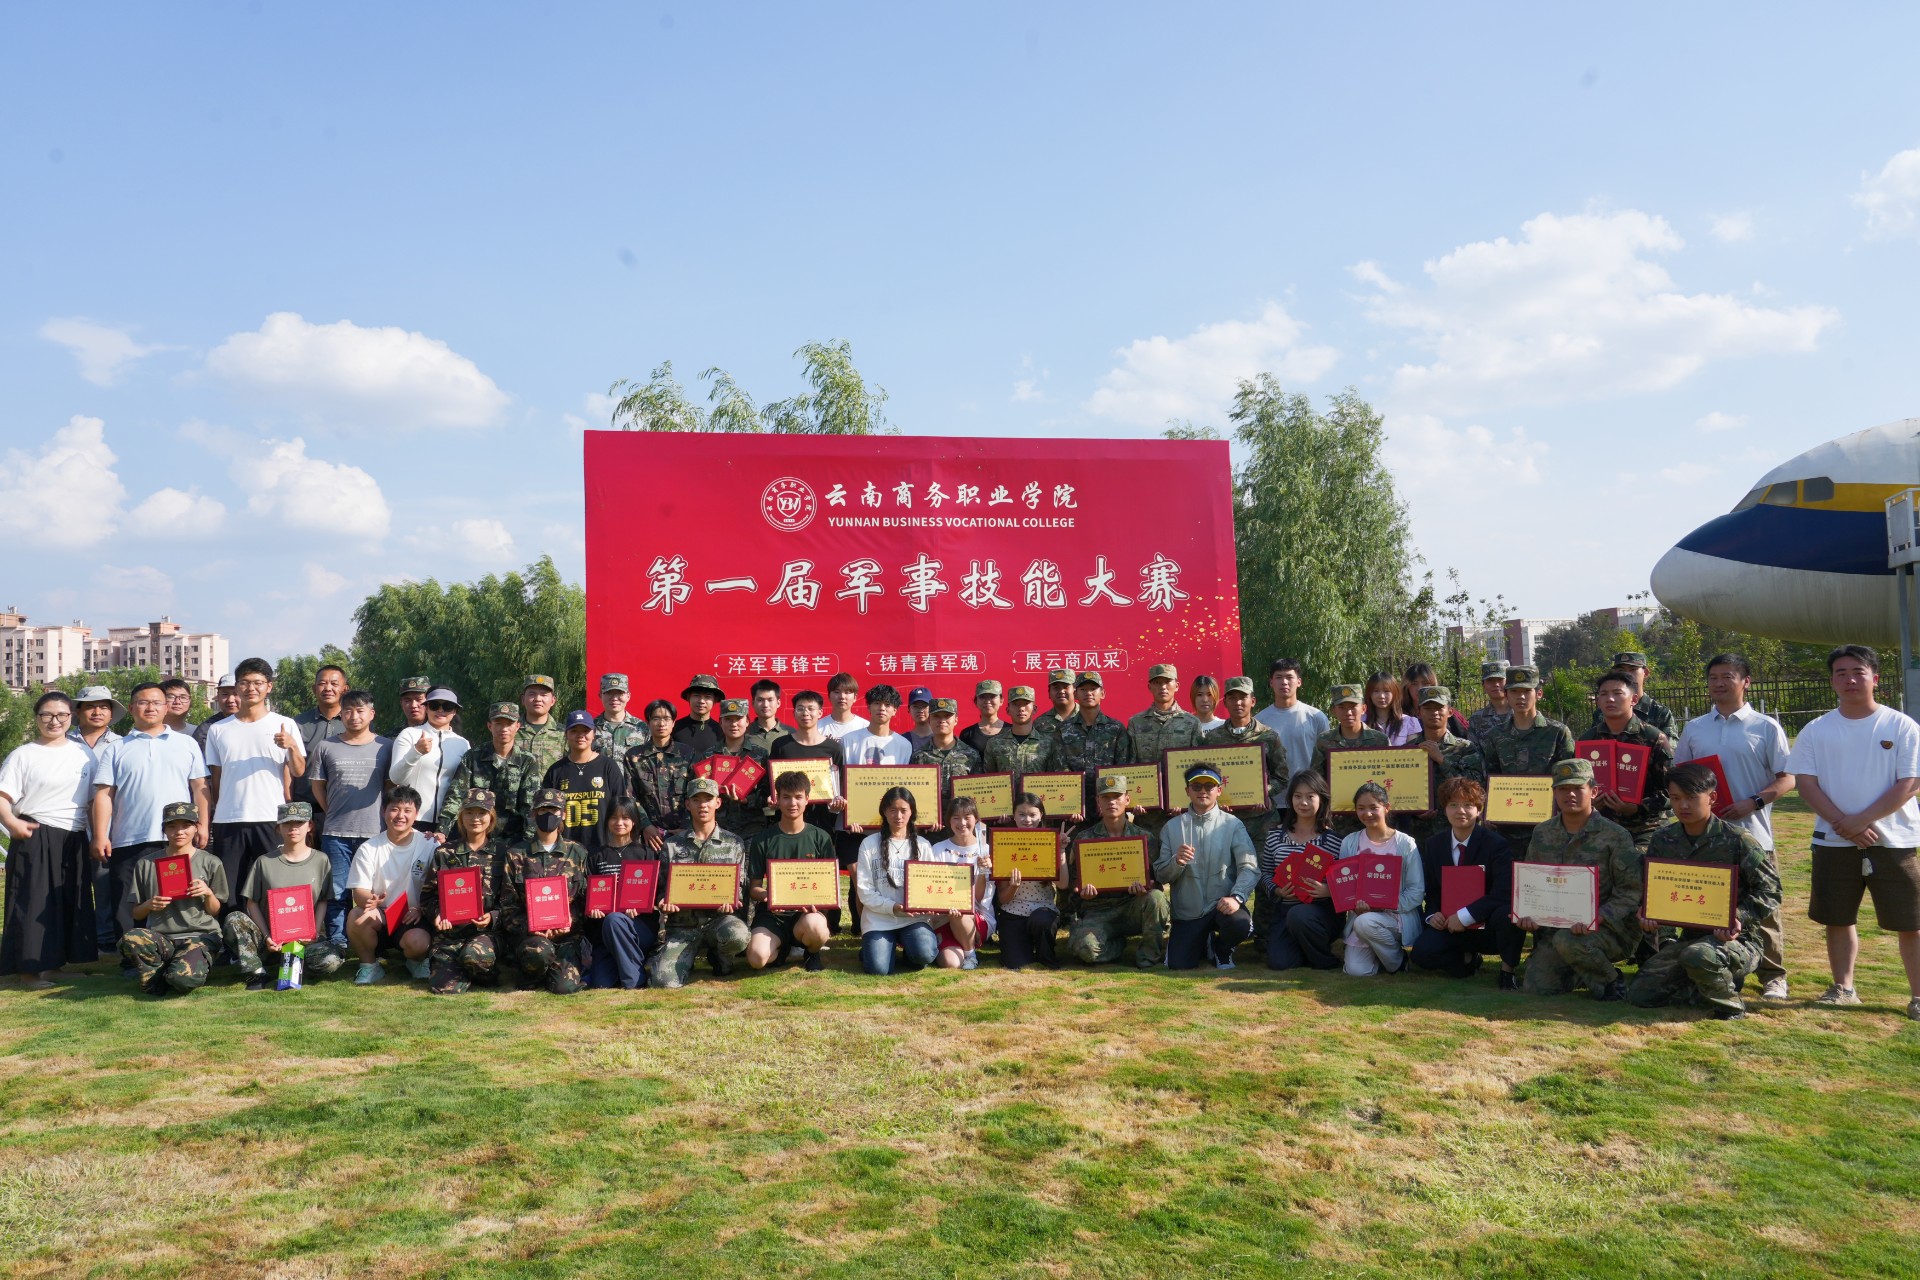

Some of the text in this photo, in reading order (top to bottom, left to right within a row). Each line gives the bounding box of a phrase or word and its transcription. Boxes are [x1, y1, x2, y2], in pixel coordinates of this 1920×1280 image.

[825, 480, 1078, 510] 云南商务职业学院
[828, 517, 1075, 528] YUNNAN BUSINESS VOCATIONAL COLLEGE
[641, 552, 1189, 615] 第一届军事技能大赛
[728, 656, 831, 675] 淬军事锋芒
[879, 653, 978, 673] 铸青春军魂
[1025, 651, 1121, 670] 展云商风采
[1505, 798, 1534, 807] 第一名
[565, 798, 599, 827] 05
[1011, 852, 1038, 862] 第二名
[1099, 863, 1126, 873] 第一名
[688, 883, 717, 891] 第三名
[790, 882, 818, 891] 第二名
[926, 885, 954, 894] 第三名
[1670, 891, 1706, 905] 第二名
